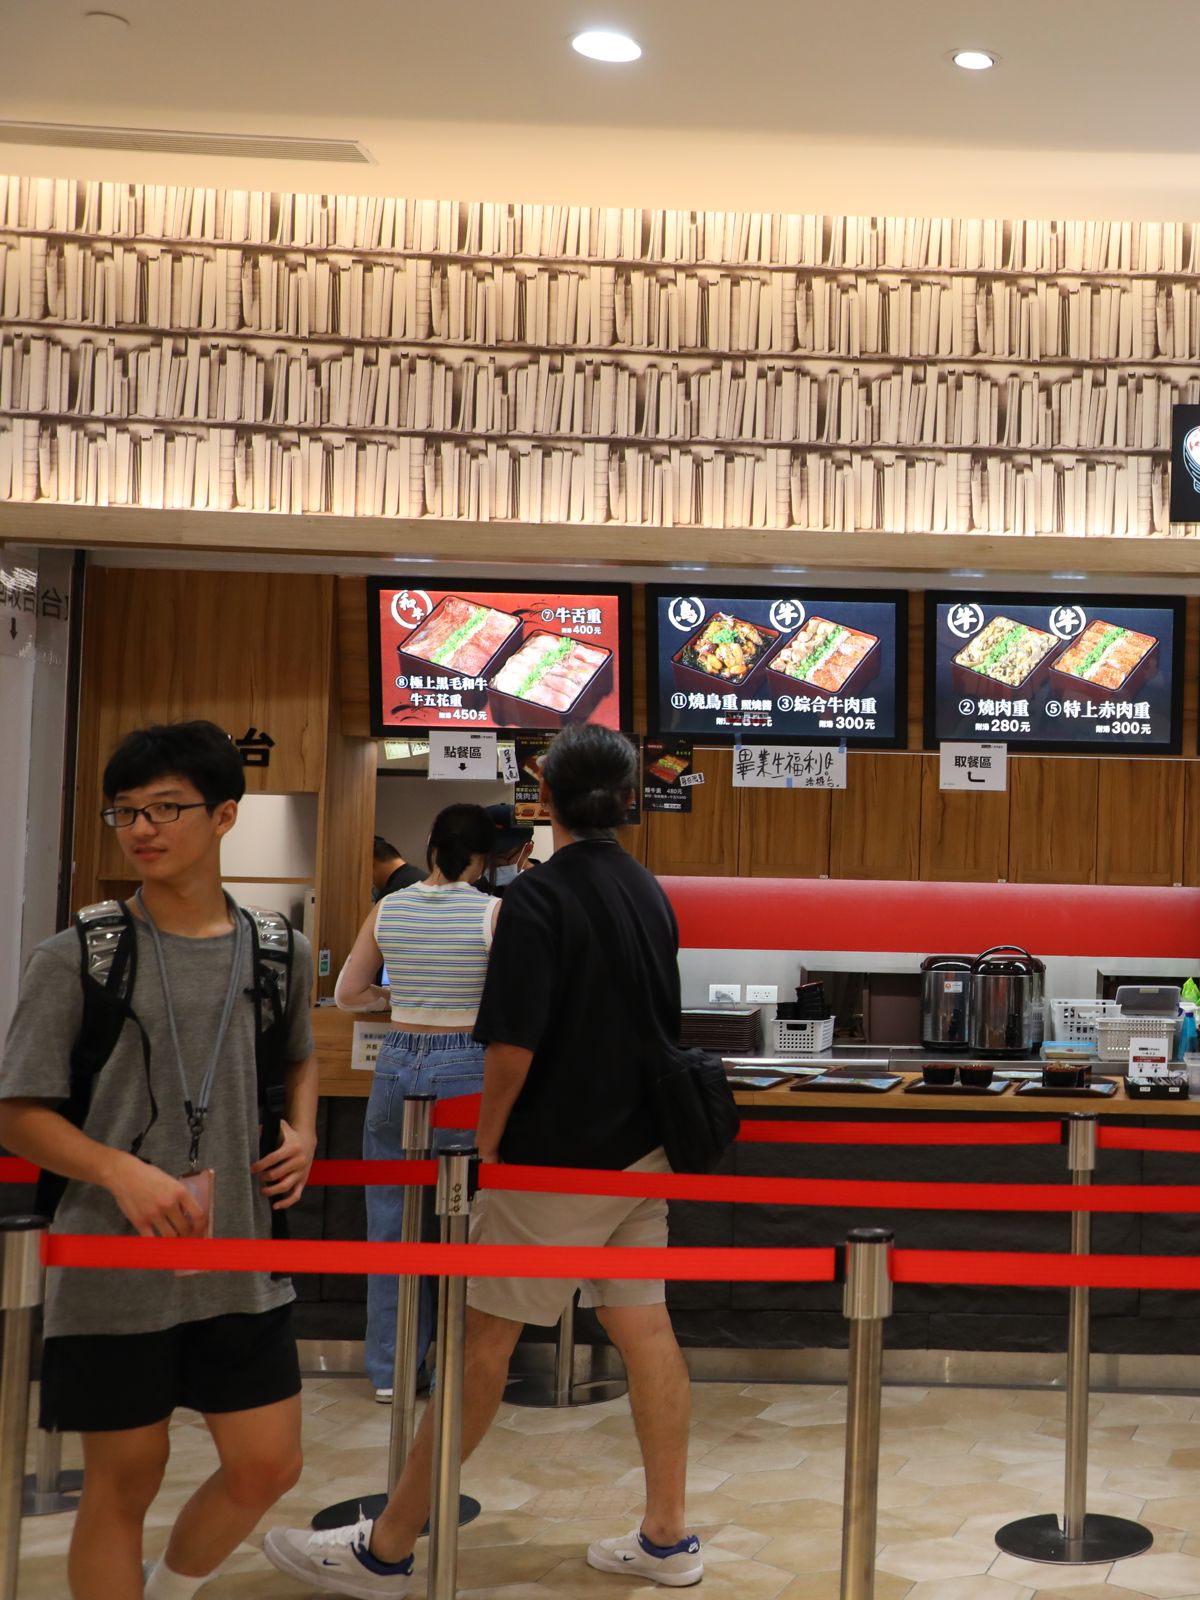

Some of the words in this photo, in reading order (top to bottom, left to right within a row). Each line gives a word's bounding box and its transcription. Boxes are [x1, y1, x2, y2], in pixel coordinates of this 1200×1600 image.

[410, 692, 463, 707] 牛五花重
[444, 746, 482, 759] 點餐區
[954, 755, 992, 769] 取餐區
